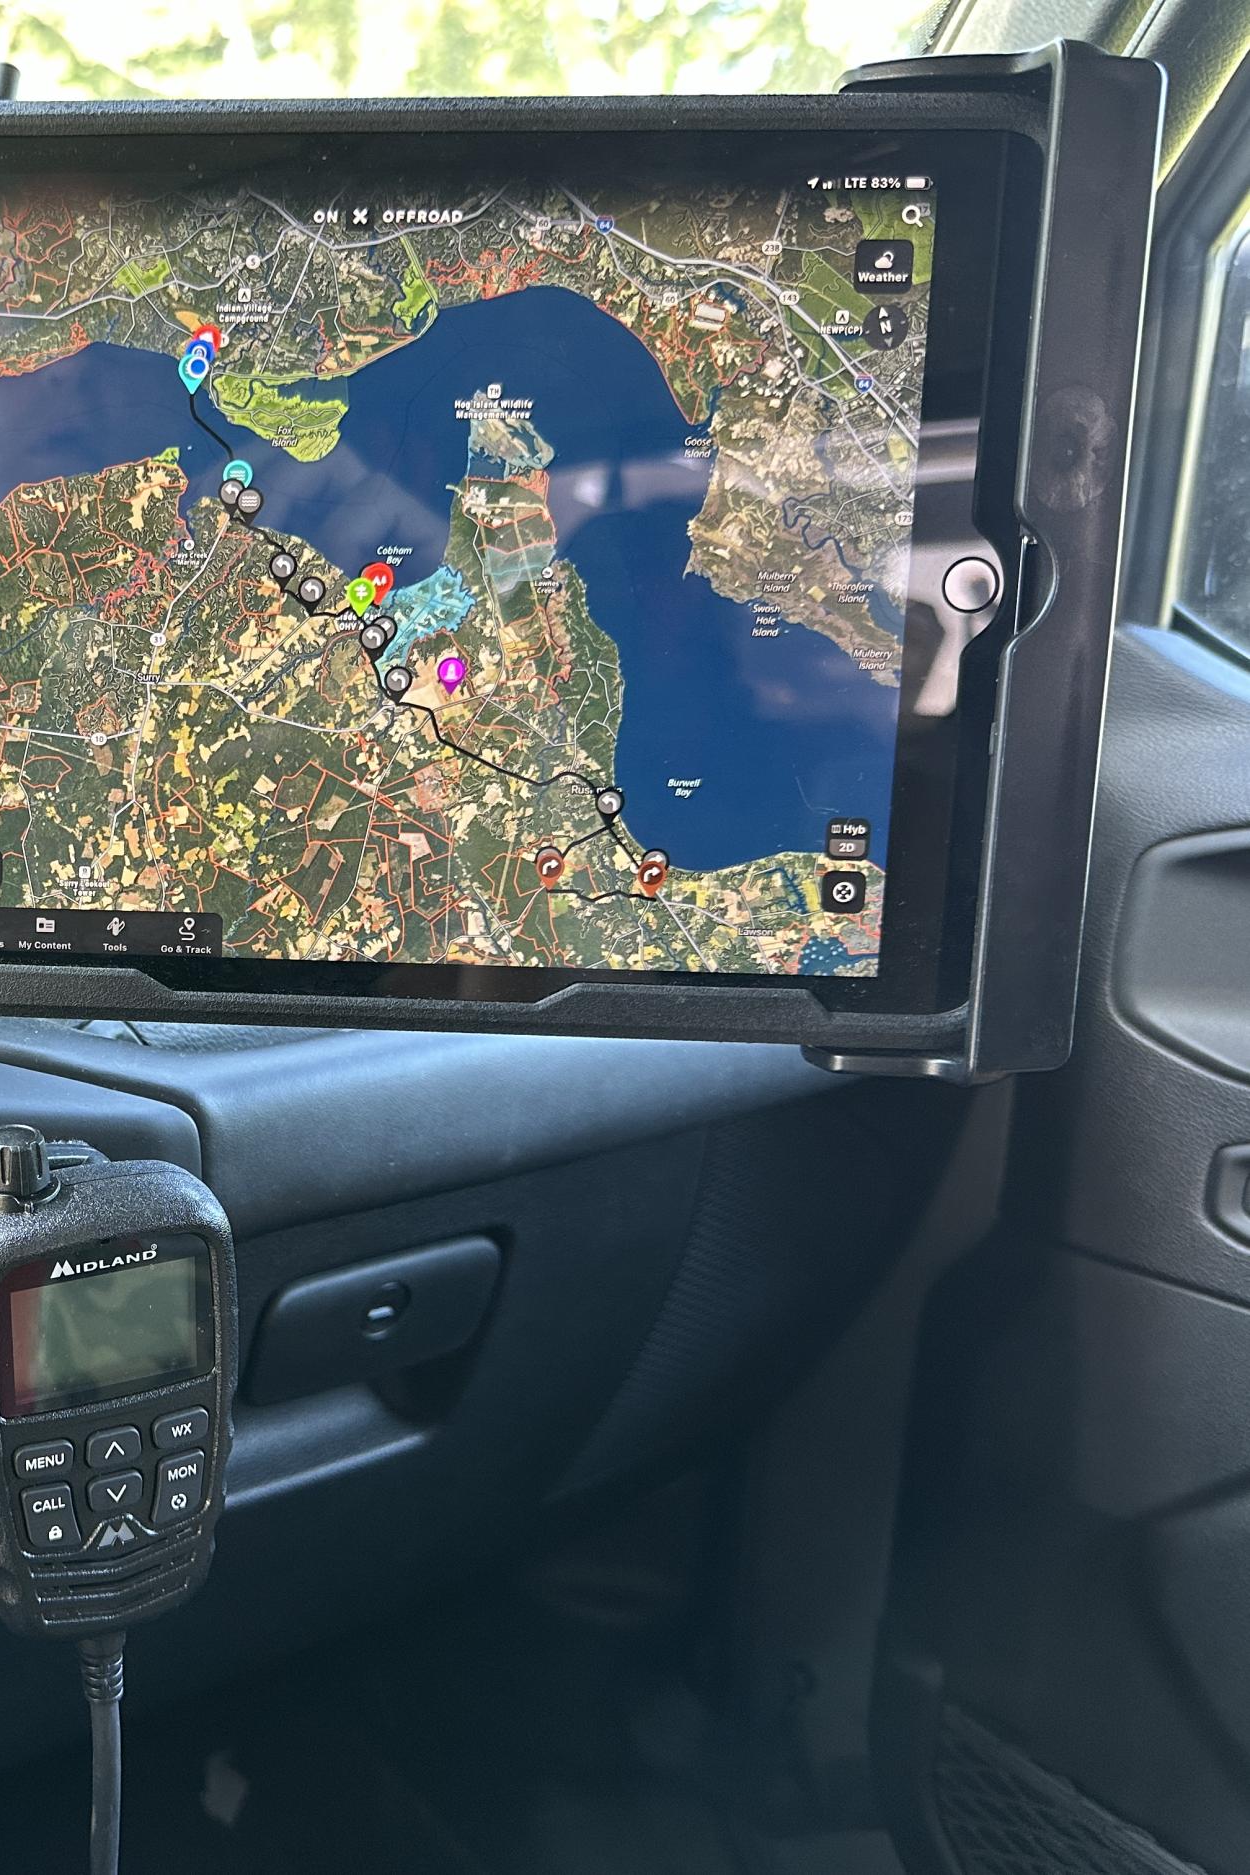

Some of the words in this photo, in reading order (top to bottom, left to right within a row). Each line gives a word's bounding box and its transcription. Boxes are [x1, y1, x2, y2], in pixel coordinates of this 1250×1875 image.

[844, 178, 867, 189] LTE
[871, 178, 900, 189] 83%
[313, 210, 338, 224] ON
[382, 209, 463, 224] OFFROAD
[538, 220, 549, 228] 60
[600, 220, 611, 229] 64
[764, 243, 780, 252] 238
[858, 272, 908, 283] Weather
[782, 293, 798, 303] 143
[216, 304, 241, 313] Indian
[243, 304, 273, 314] Village
[219, 314, 269, 324] Campground
[820, 325, 863, 336] NEWP(CP)
[880, 320, 892, 334] N
[858, 380, 870, 389] 64
[454, 400, 470, 411] Hog
[471, 400, 498, 410] Island
[500, 399, 533, 410] Wildlife
[455, 410, 509, 420] Management
[511, 411, 531, 419] Area
[277, 425, 292, 434] Fox
[271, 438, 298, 447] Island
[684, 437, 712, 447] Goose
[684, 449, 711, 458] Island
[376, 546, 413, 555] Cobham
[386, 556, 403, 566] Bay
[757, 572, 797, 582] Mulberry
[762, 584, 790, 592] Island
[838, 594, 865, 603] Island
[752, 605, 781, 613] Swash
[755, 616, 777, 625] Hole
[751, 628, 779, 637] Island
[853, 649, 893, 660] Mulberry
[858, 661, 886, 670] Island
[137, 673, 161, 683] Surry
[95, 735, 104, 743] 10
[667, 779, 702, 788] Burwell
[674, 788, 692, 798] Bay
[842, 824, 867, 836] Hyb
[838, 843, 855, 853] 2D
[72, 889, 96, 897] Tower
[737, 927, 774, 936] Lawson
[18, 941, 33, 951] My
[35, 941, 72, 951] Content
[102, 943, 128, 952] Tools
[160, 945, 174, 953] Go
[175, 945, 183, 954] &
[184, 945, 212, 954] Track
[50, 1248, 158, 1279] MIDLAND
[171, 1421, 193, 1438] WX
[25, 1452, 65, 1472] MENU
[167, 1463, 197, 1483] MON
[32, 1496, 66, 1514] CALL
